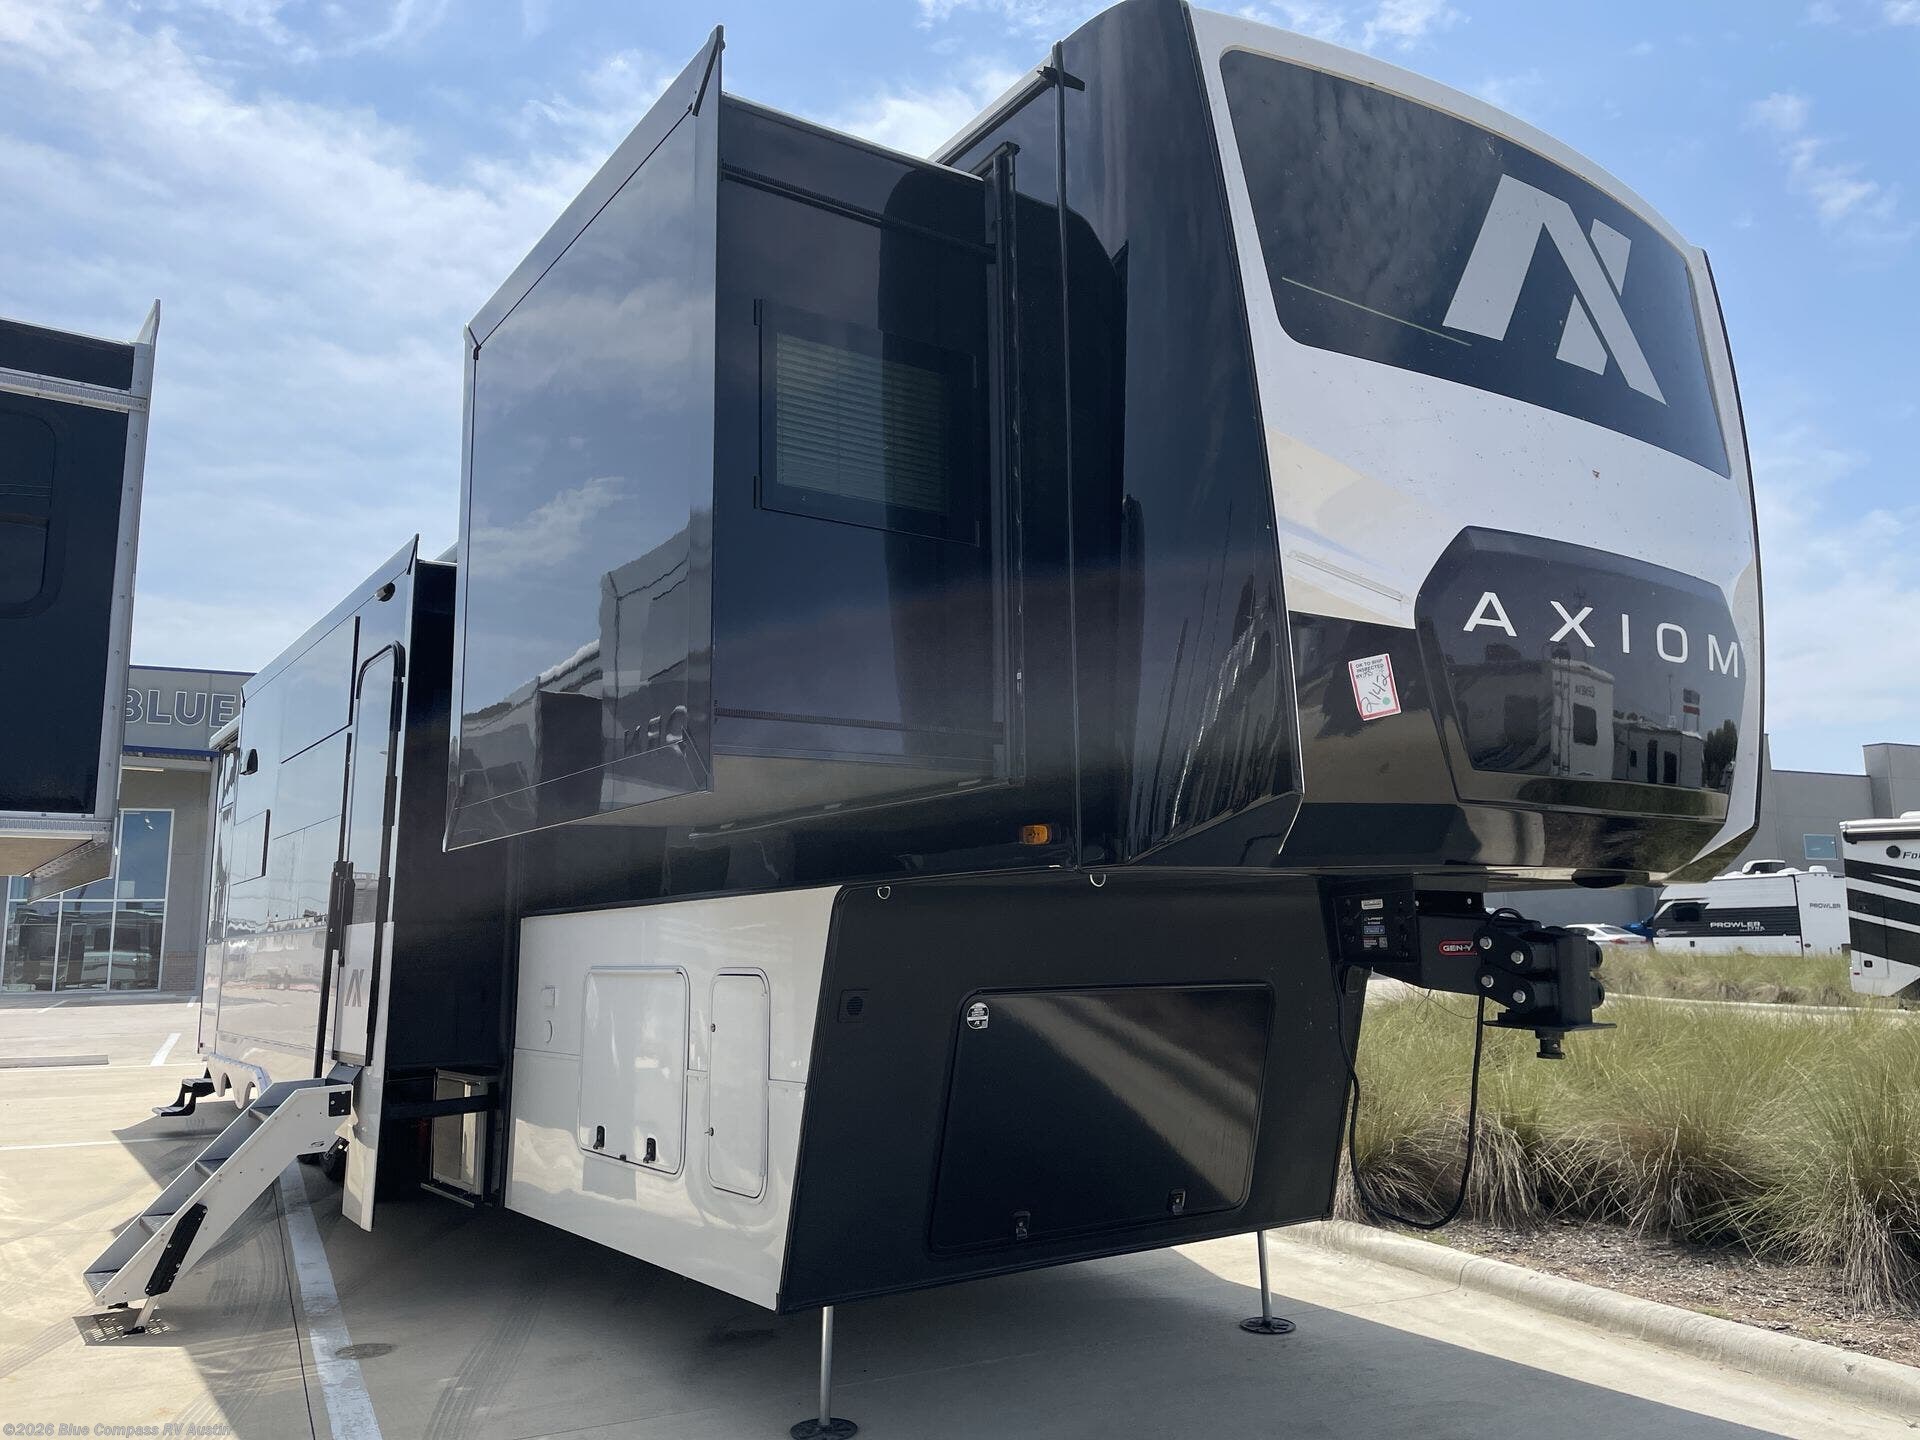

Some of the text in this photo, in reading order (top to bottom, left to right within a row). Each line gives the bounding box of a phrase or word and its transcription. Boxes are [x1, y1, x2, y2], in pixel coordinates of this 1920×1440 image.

[1463, 591, 1739, 678] AXIOM
[125, 687, 237, 728] BLUE
[1902, 851, 1920, 860] Fo
[1443, 943, 1474, 952] GEN-Y
